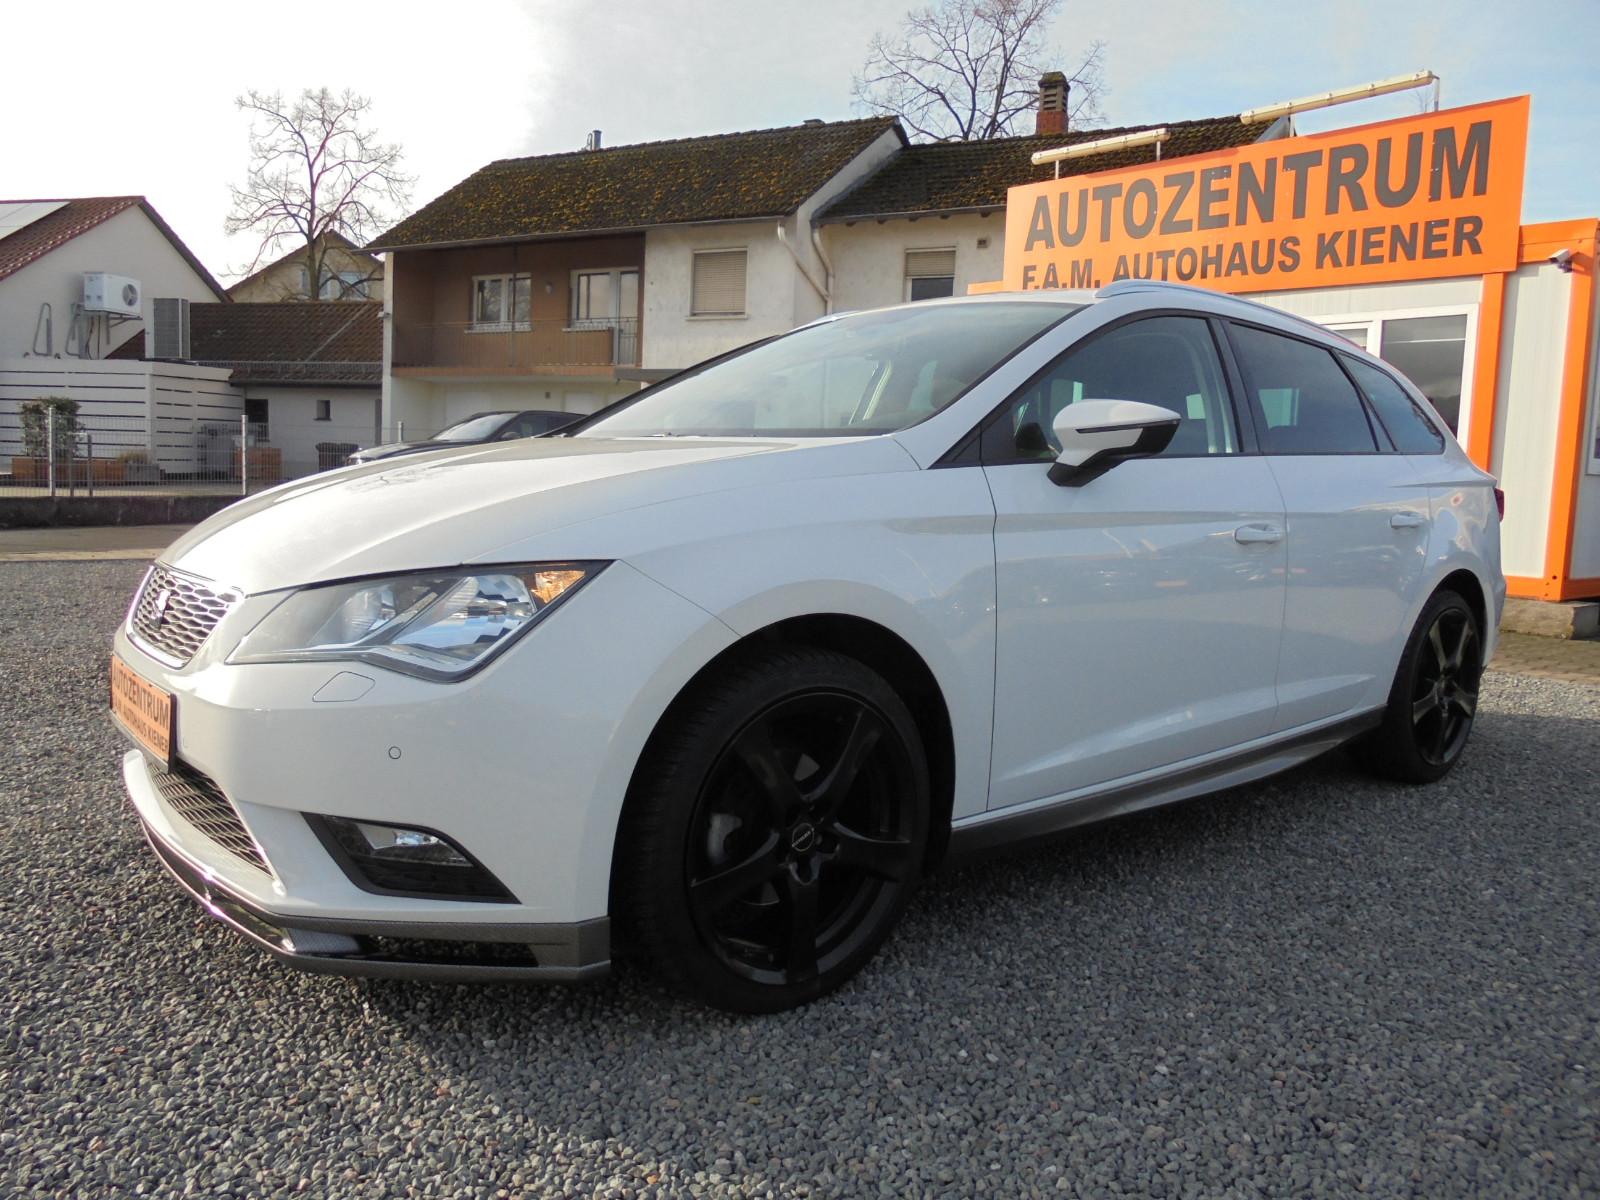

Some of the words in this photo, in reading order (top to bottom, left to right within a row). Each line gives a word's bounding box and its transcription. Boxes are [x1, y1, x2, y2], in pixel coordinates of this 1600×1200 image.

[1024, 119, 1492, 252] AUTOZENTRUM
[1111, 236, 1301, 283] AUTOHAUS
[1315, 215, 1483, 269] KIENER
[113, 662, 169, 731] AUTOZENTRUM
